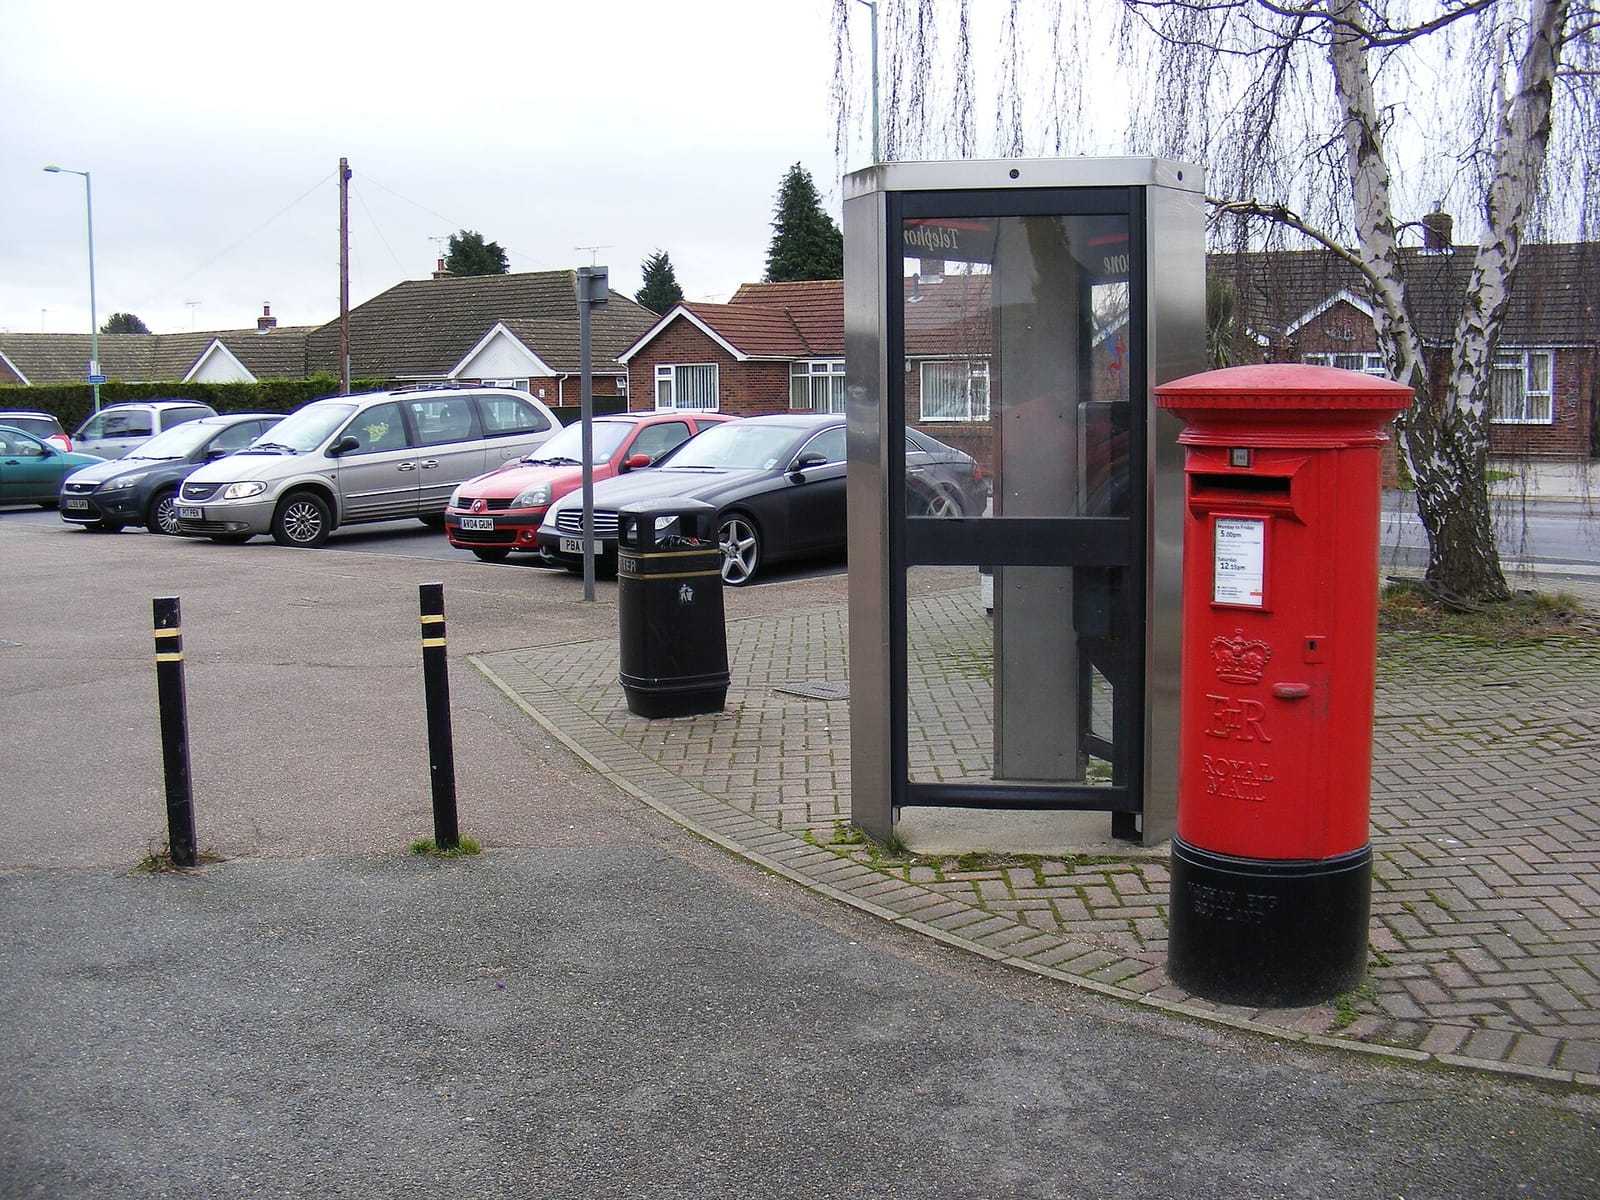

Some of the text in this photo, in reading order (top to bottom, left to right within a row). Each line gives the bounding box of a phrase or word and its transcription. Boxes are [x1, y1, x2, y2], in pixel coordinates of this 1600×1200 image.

[566, 540, 581, 551] PBA
[1202, 754, 1275, 781] ROYAL
[1206, 776, 1267, 801] MAIL
